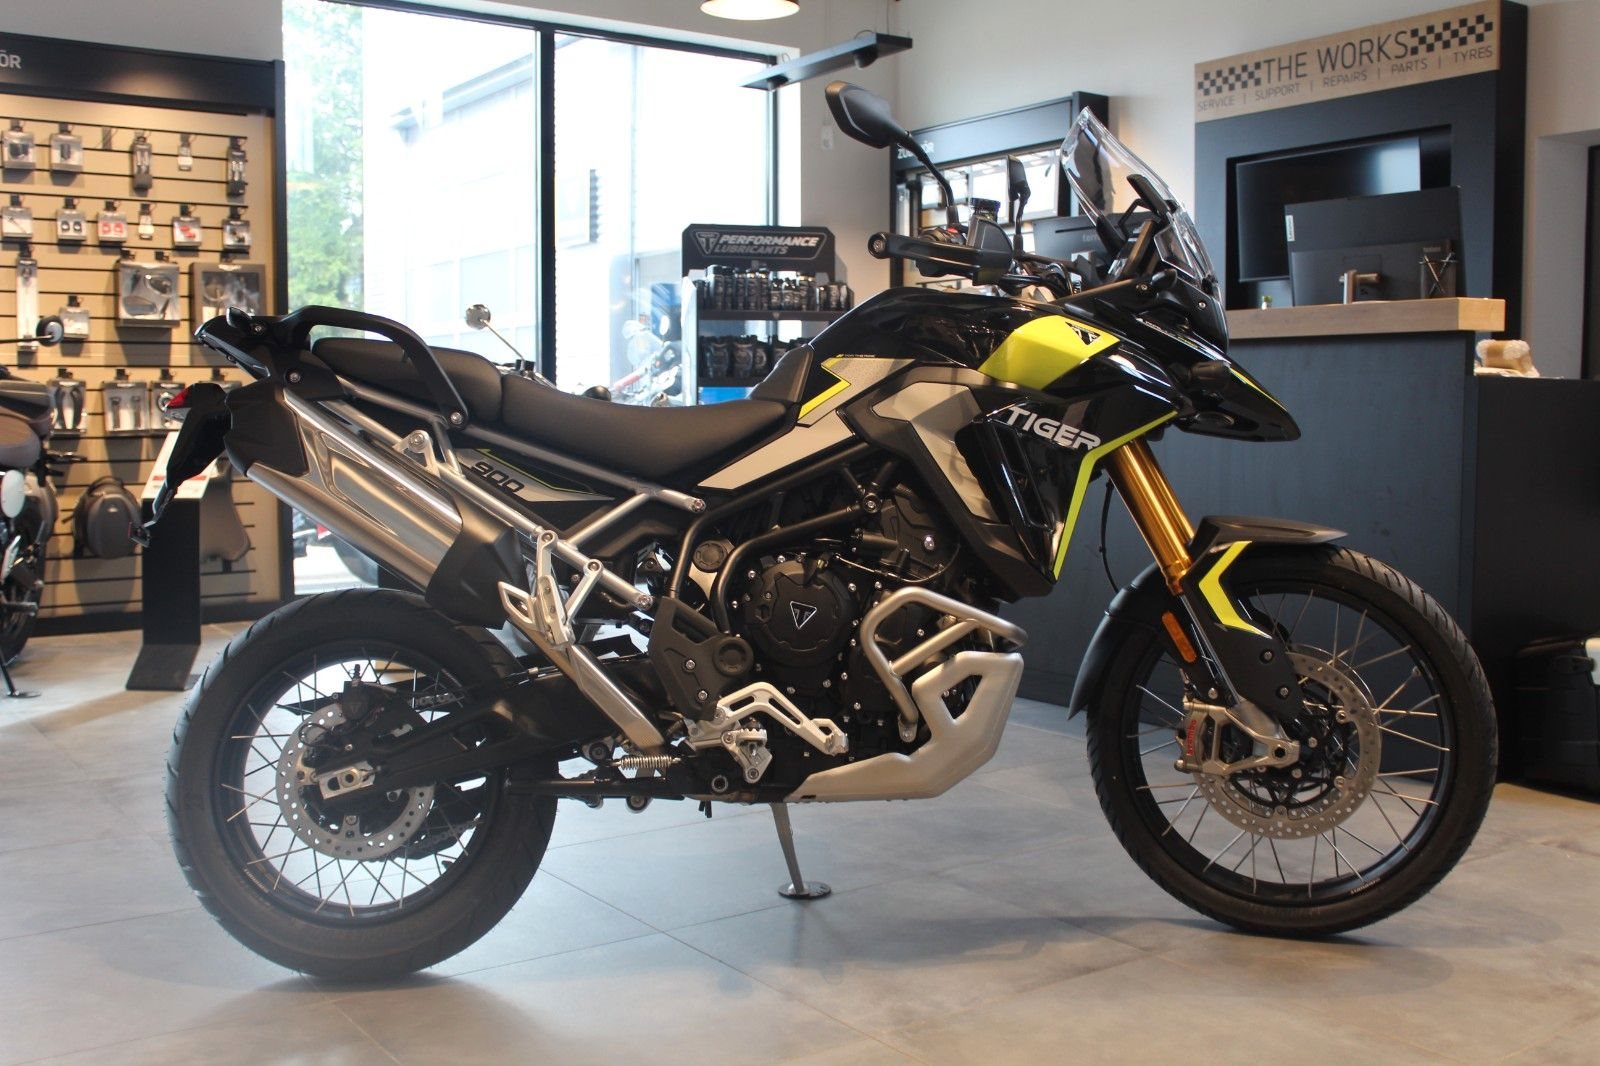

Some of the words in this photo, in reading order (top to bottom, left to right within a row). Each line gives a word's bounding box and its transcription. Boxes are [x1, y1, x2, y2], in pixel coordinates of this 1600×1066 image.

[1263, 52, 1308, 84] THE
[1317, 31, 1410, 74] WORKS
[1197, 95, 1236, 113] SERVICE
[1255, 82, 1301, 101] SUPPORT
[1323, 70, 1368, 89] REPAIRS
[1391, 58, 1429, 74] PARTS
[1453, 46, 1493, 63] TYRES
[714, 244, 789, 255] LUBRICANTS
[720, 234, 820, 247] PERFORMANCE
[1009, 405, 1101, 451] TIGER
[470, 461, 525, 495] 900
